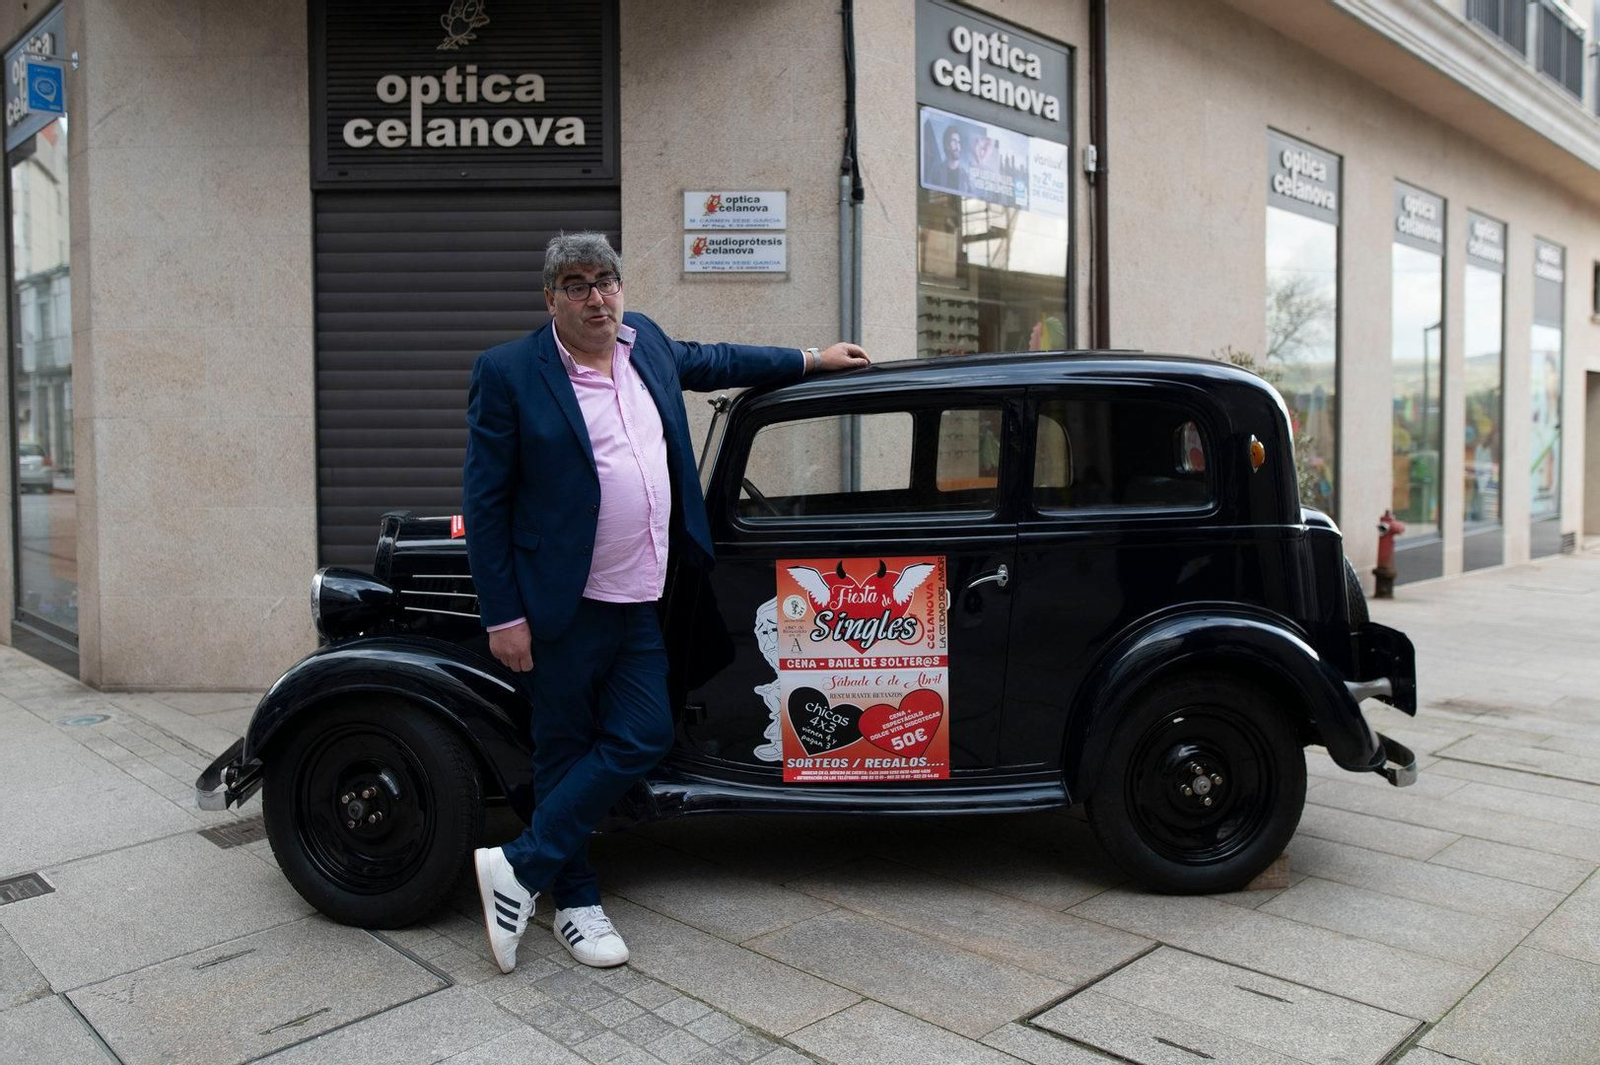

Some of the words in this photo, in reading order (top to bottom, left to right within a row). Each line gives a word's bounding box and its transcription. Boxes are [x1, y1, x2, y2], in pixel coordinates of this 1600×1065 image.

[951, 24, 1042, 81] optica
[376, 64, 546, 106] optica
[932, 57, 1061, 122] celanova
[343, 113, 587, 148] celanova
[1283, 148, 1327, 181] optica
[725, 195, 760, 205] optica
[1273, 171, 1336, 210] celanova
[719, 203, 769, 213] celanova
[705, 246, 754, 255] celanova
[708, 236, 783, 248] audioprótesis
[829, 584, 878, 610] Fiesta
[881, 594, 893, 608] de
[926, 582, 935, 650] CELANOVA
[810, 609, 918, 649] Singles
[939, 637, 946, 649] LA
[786, 658, 817, 669] CENA
[828, 657, 860, 668] BAILE
[862, 657, 877, 667] DE
[879, 656, 940, 667] SOLTER@S
[887, 674, 900, 686] de
[904, 671, 943, 689] Abril
[805, 702, 850, 726] chicas
[882, 711, 924, 730] ESPECTÁCULO
[889, 710, 906, 720] CENA
[870, 730, 890, 741] DOLCE
[890, 725, 904, 734] VITA
[904, 711, 941, 728] DISCOTECAS
[801, 735, 823, 747] pagan
[891, 728, 928, 751] 50€
[787, 757, 850, 768] SORTEOS
[852, 758, 861, 768] /
